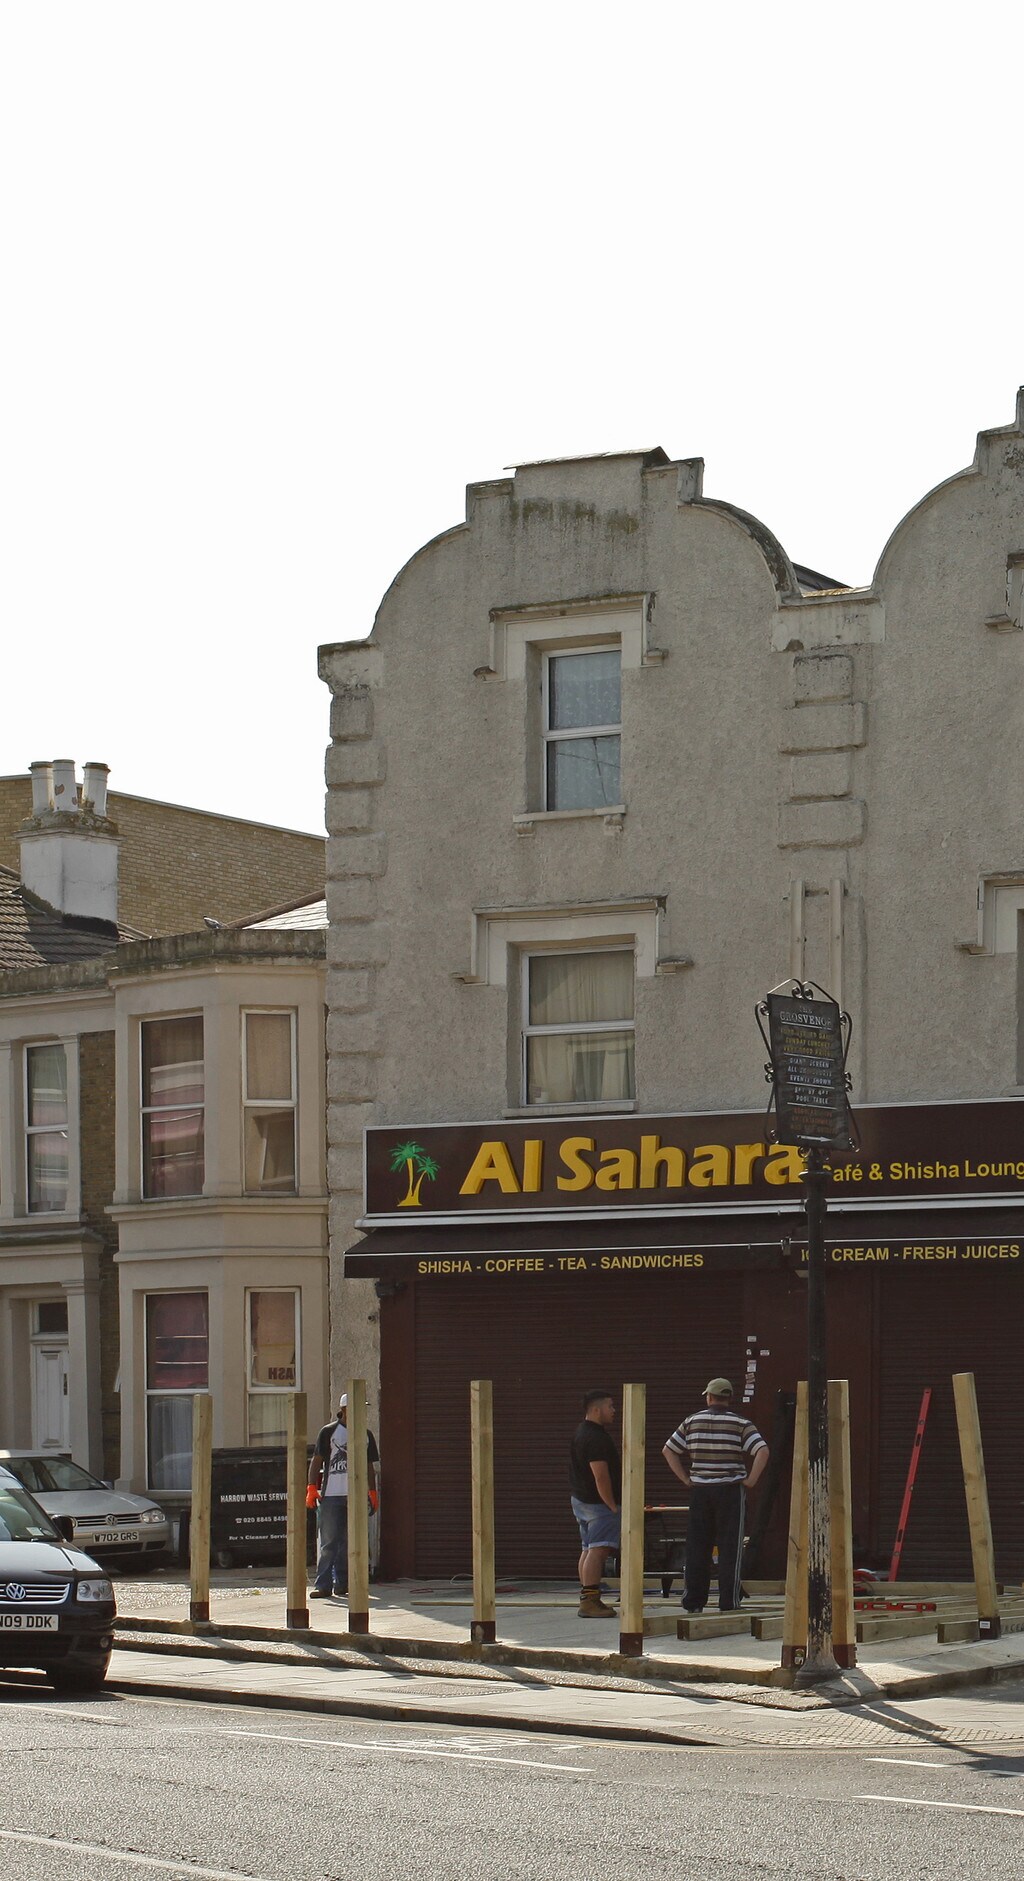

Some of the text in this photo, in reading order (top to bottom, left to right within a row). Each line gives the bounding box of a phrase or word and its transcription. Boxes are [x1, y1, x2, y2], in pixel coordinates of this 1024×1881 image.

[458, 1135, 804, 1196] Al Sahara
[822, 1163, 863, 1182] afé
[868, 1162, 884, 1181] &
[889, 1161, 960, 1180] Shisha
[831, 1247, 889, 1261] CREAM
[902, 1246, 957, 1260] FRESH
[961, 1244, 1020, 1259] JUICES
[417, 1260, 473, 1274] SHISHA
[484, 1258, 545, 1273] COFFEE
[557, 1257, 588, 1271] TEA
[600, 1254, 704, 1270] SANDWICHES
[220, 1493, 246, 1503] HARROW
[247, 1493, 268, 1502] WASTE
[94, 1532, 138, 1543] W702 GRS
[26, 1615, 53, 1628] DDK
